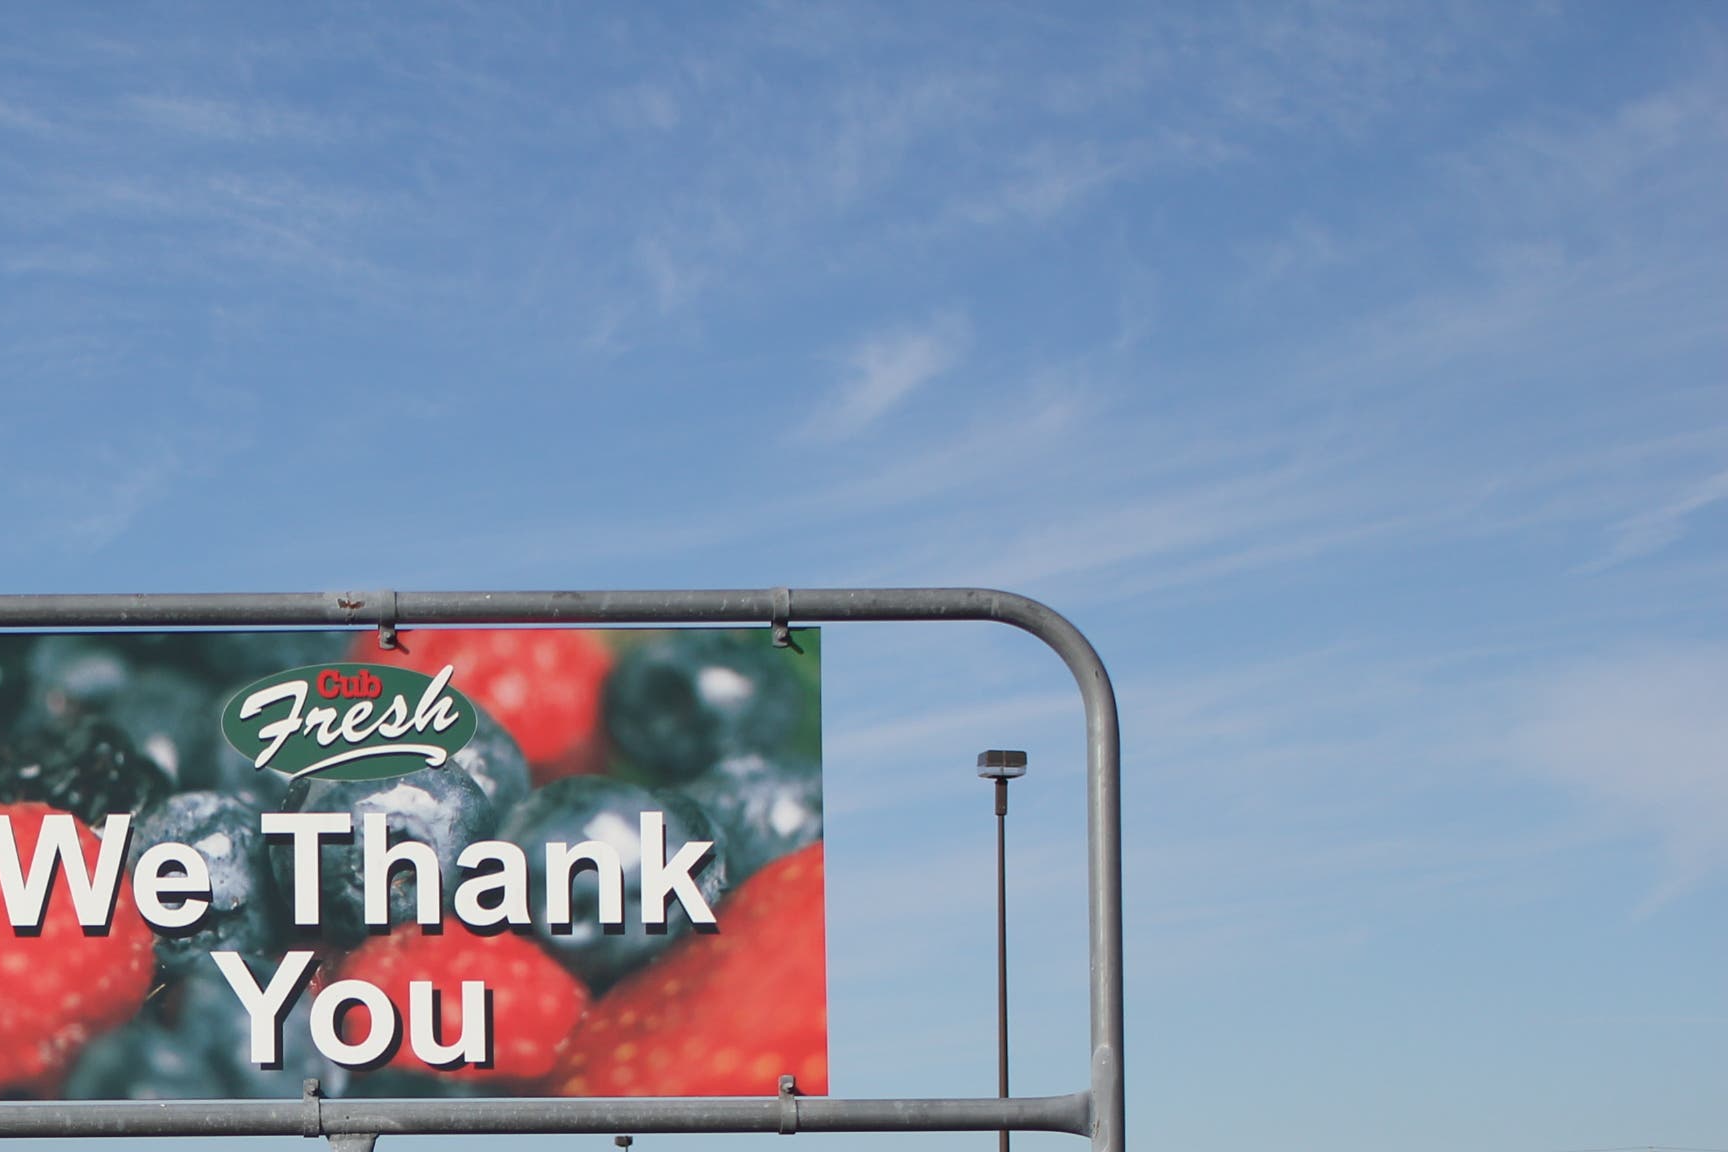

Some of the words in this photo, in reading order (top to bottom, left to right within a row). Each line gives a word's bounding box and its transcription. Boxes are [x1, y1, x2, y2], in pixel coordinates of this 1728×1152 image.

[239, 664, 460, 769] Fresh
[316, 669, 382, 698] Cub
[260, 811, 717, 927] Thank
[210, 950, 487, 1063] You
